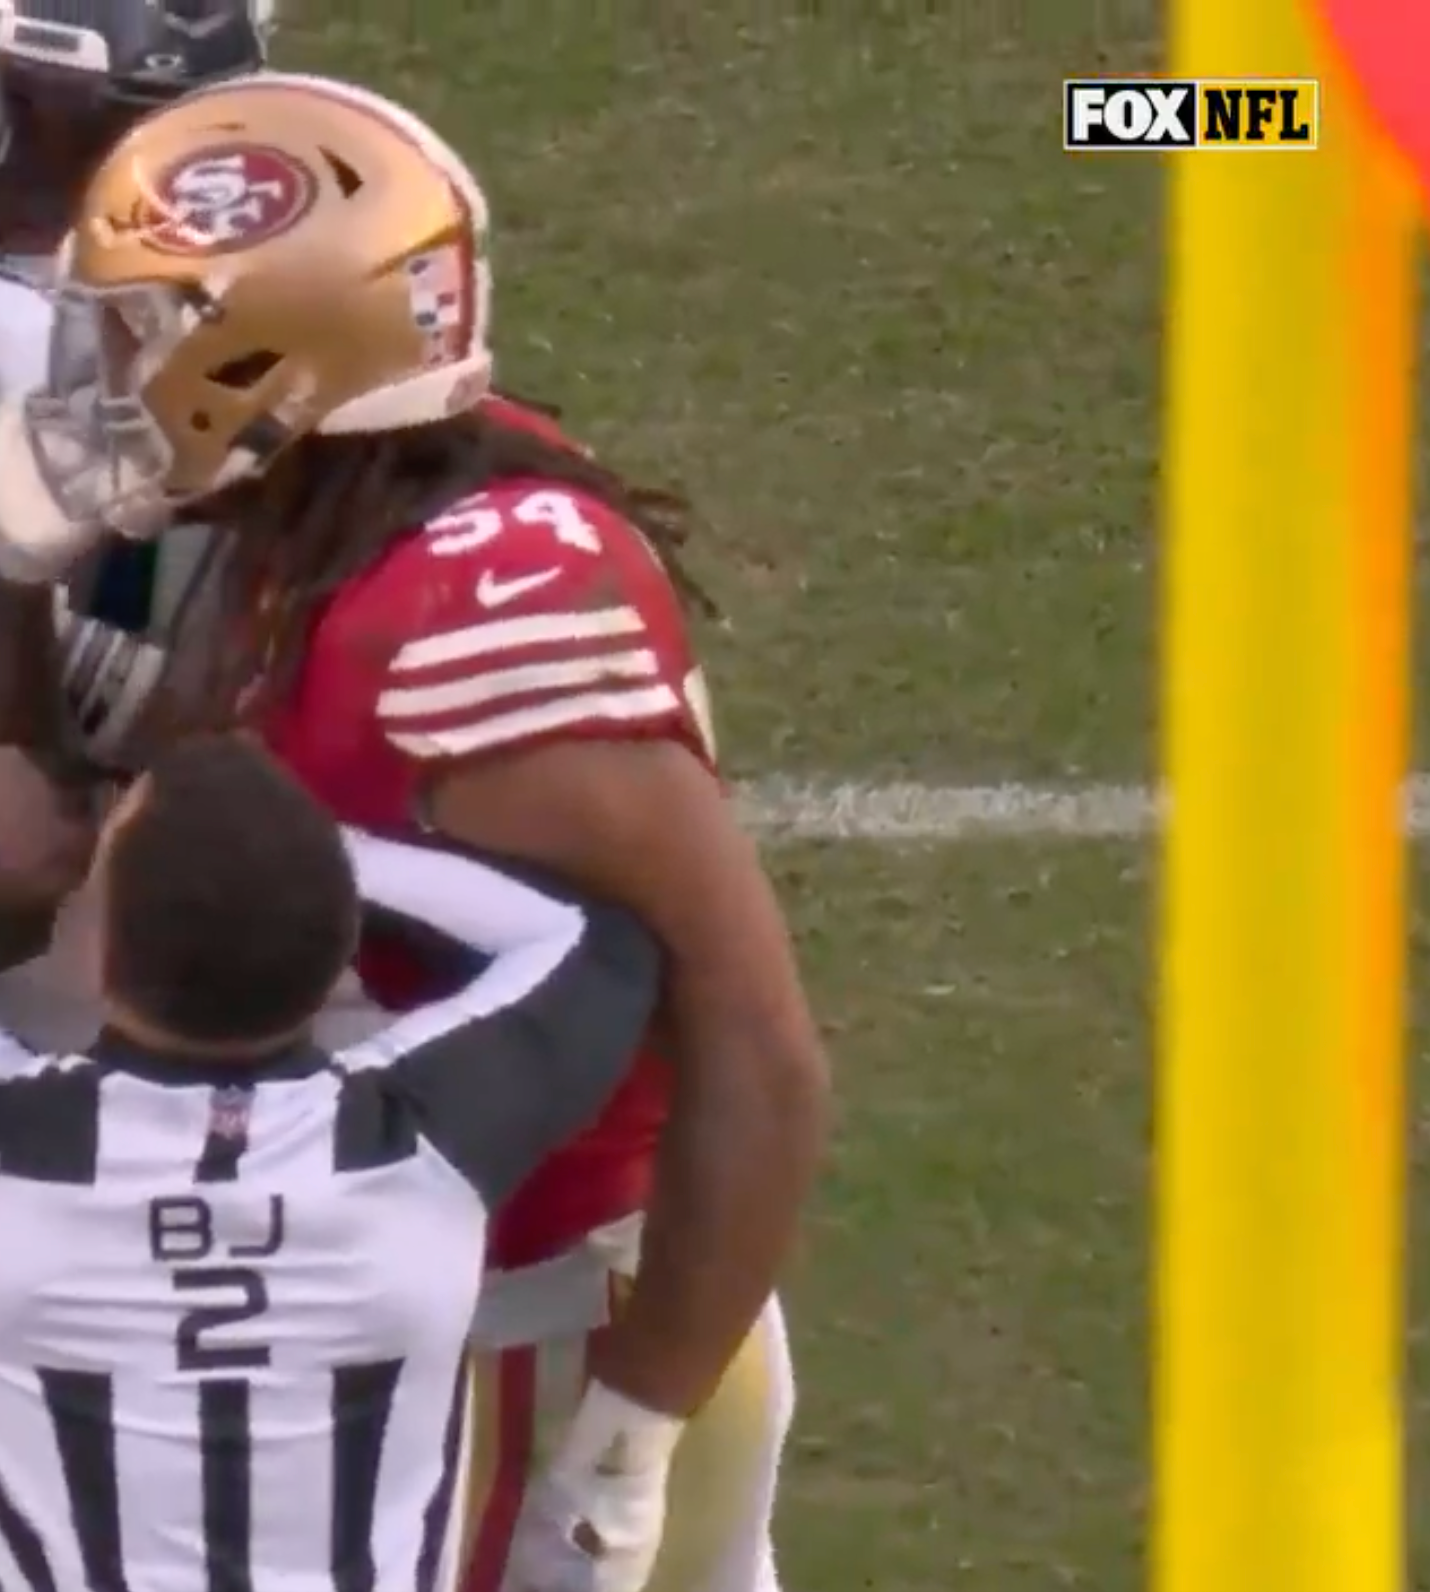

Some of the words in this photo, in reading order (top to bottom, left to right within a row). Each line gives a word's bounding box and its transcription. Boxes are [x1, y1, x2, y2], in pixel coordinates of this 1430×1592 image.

[425, 489, 603, 556] 54
[150, 1195, 284, 1260] BJ
[172, 1268, 270, 1370] 2
